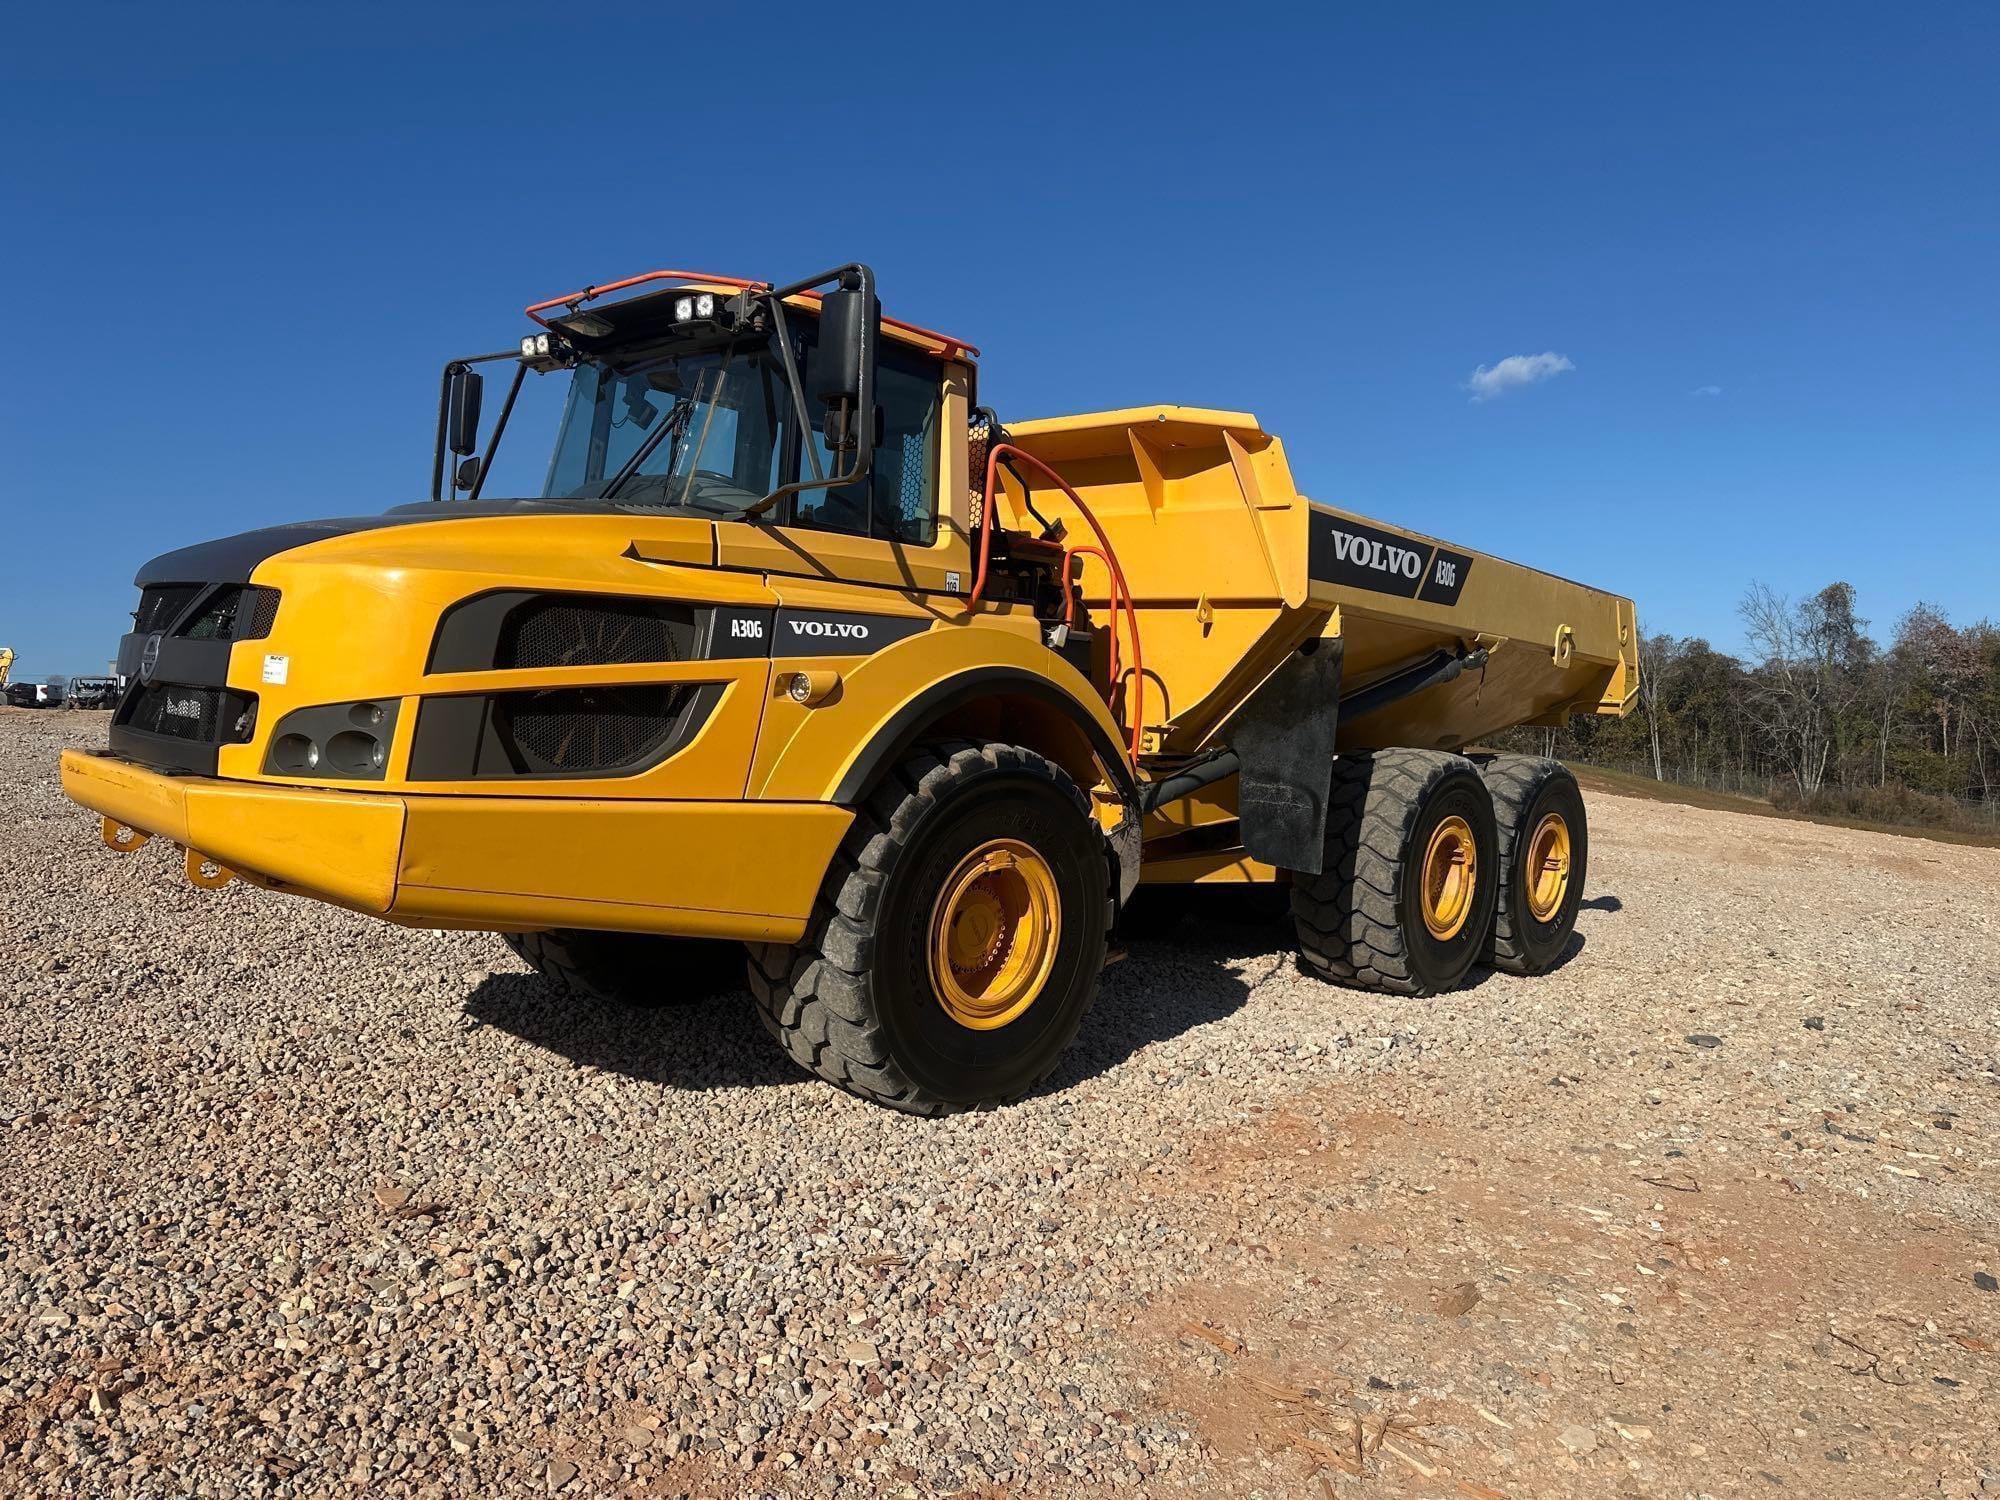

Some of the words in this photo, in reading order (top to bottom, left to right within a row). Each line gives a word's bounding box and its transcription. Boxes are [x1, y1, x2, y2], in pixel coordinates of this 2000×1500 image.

[1331, 529, 1421, 579] VOLVO
[1435, 560, 1456, 588] A30G
[731, 619, 763, 638] A30G
[788, 620, 869, 639] VOLVO
